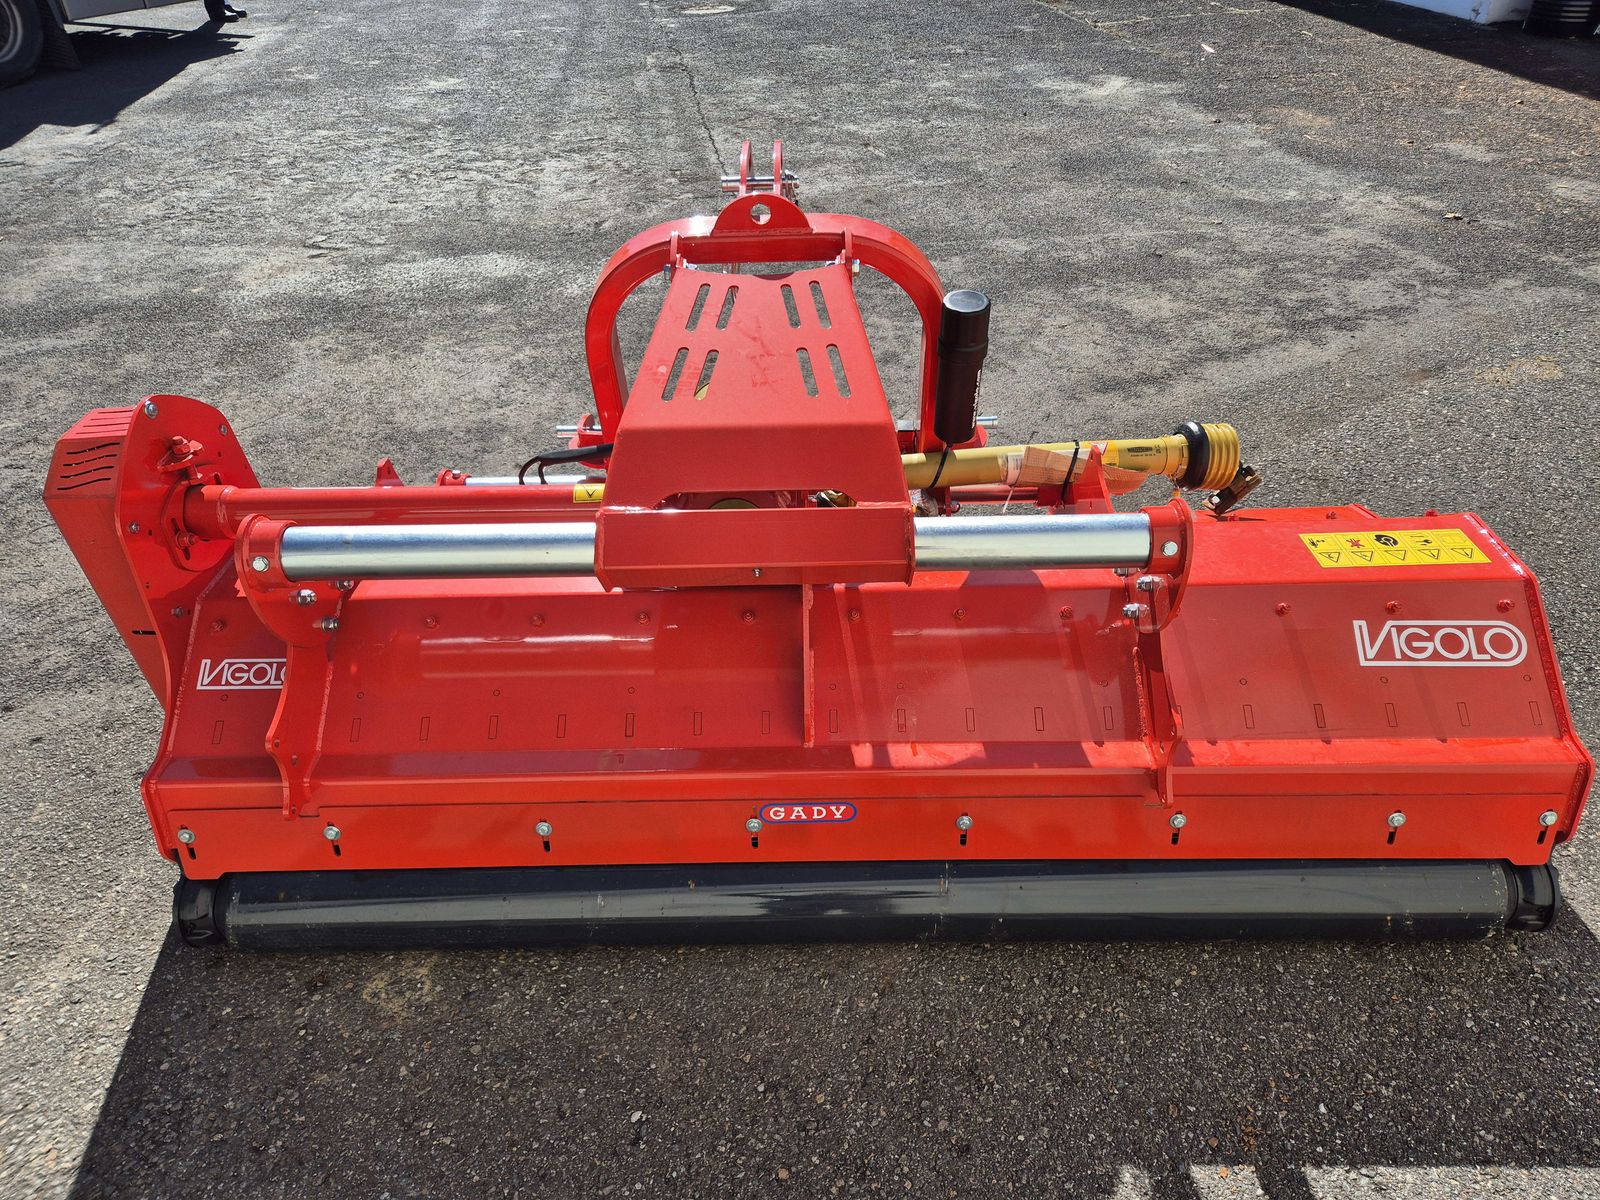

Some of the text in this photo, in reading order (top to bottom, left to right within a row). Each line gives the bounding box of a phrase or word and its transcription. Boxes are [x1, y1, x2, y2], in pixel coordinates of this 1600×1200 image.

[1353, 620, 1519, 660] VIGOLO
[198, 659, 286, 686] VIGOL
[769, 806, 847, 820] GADY
